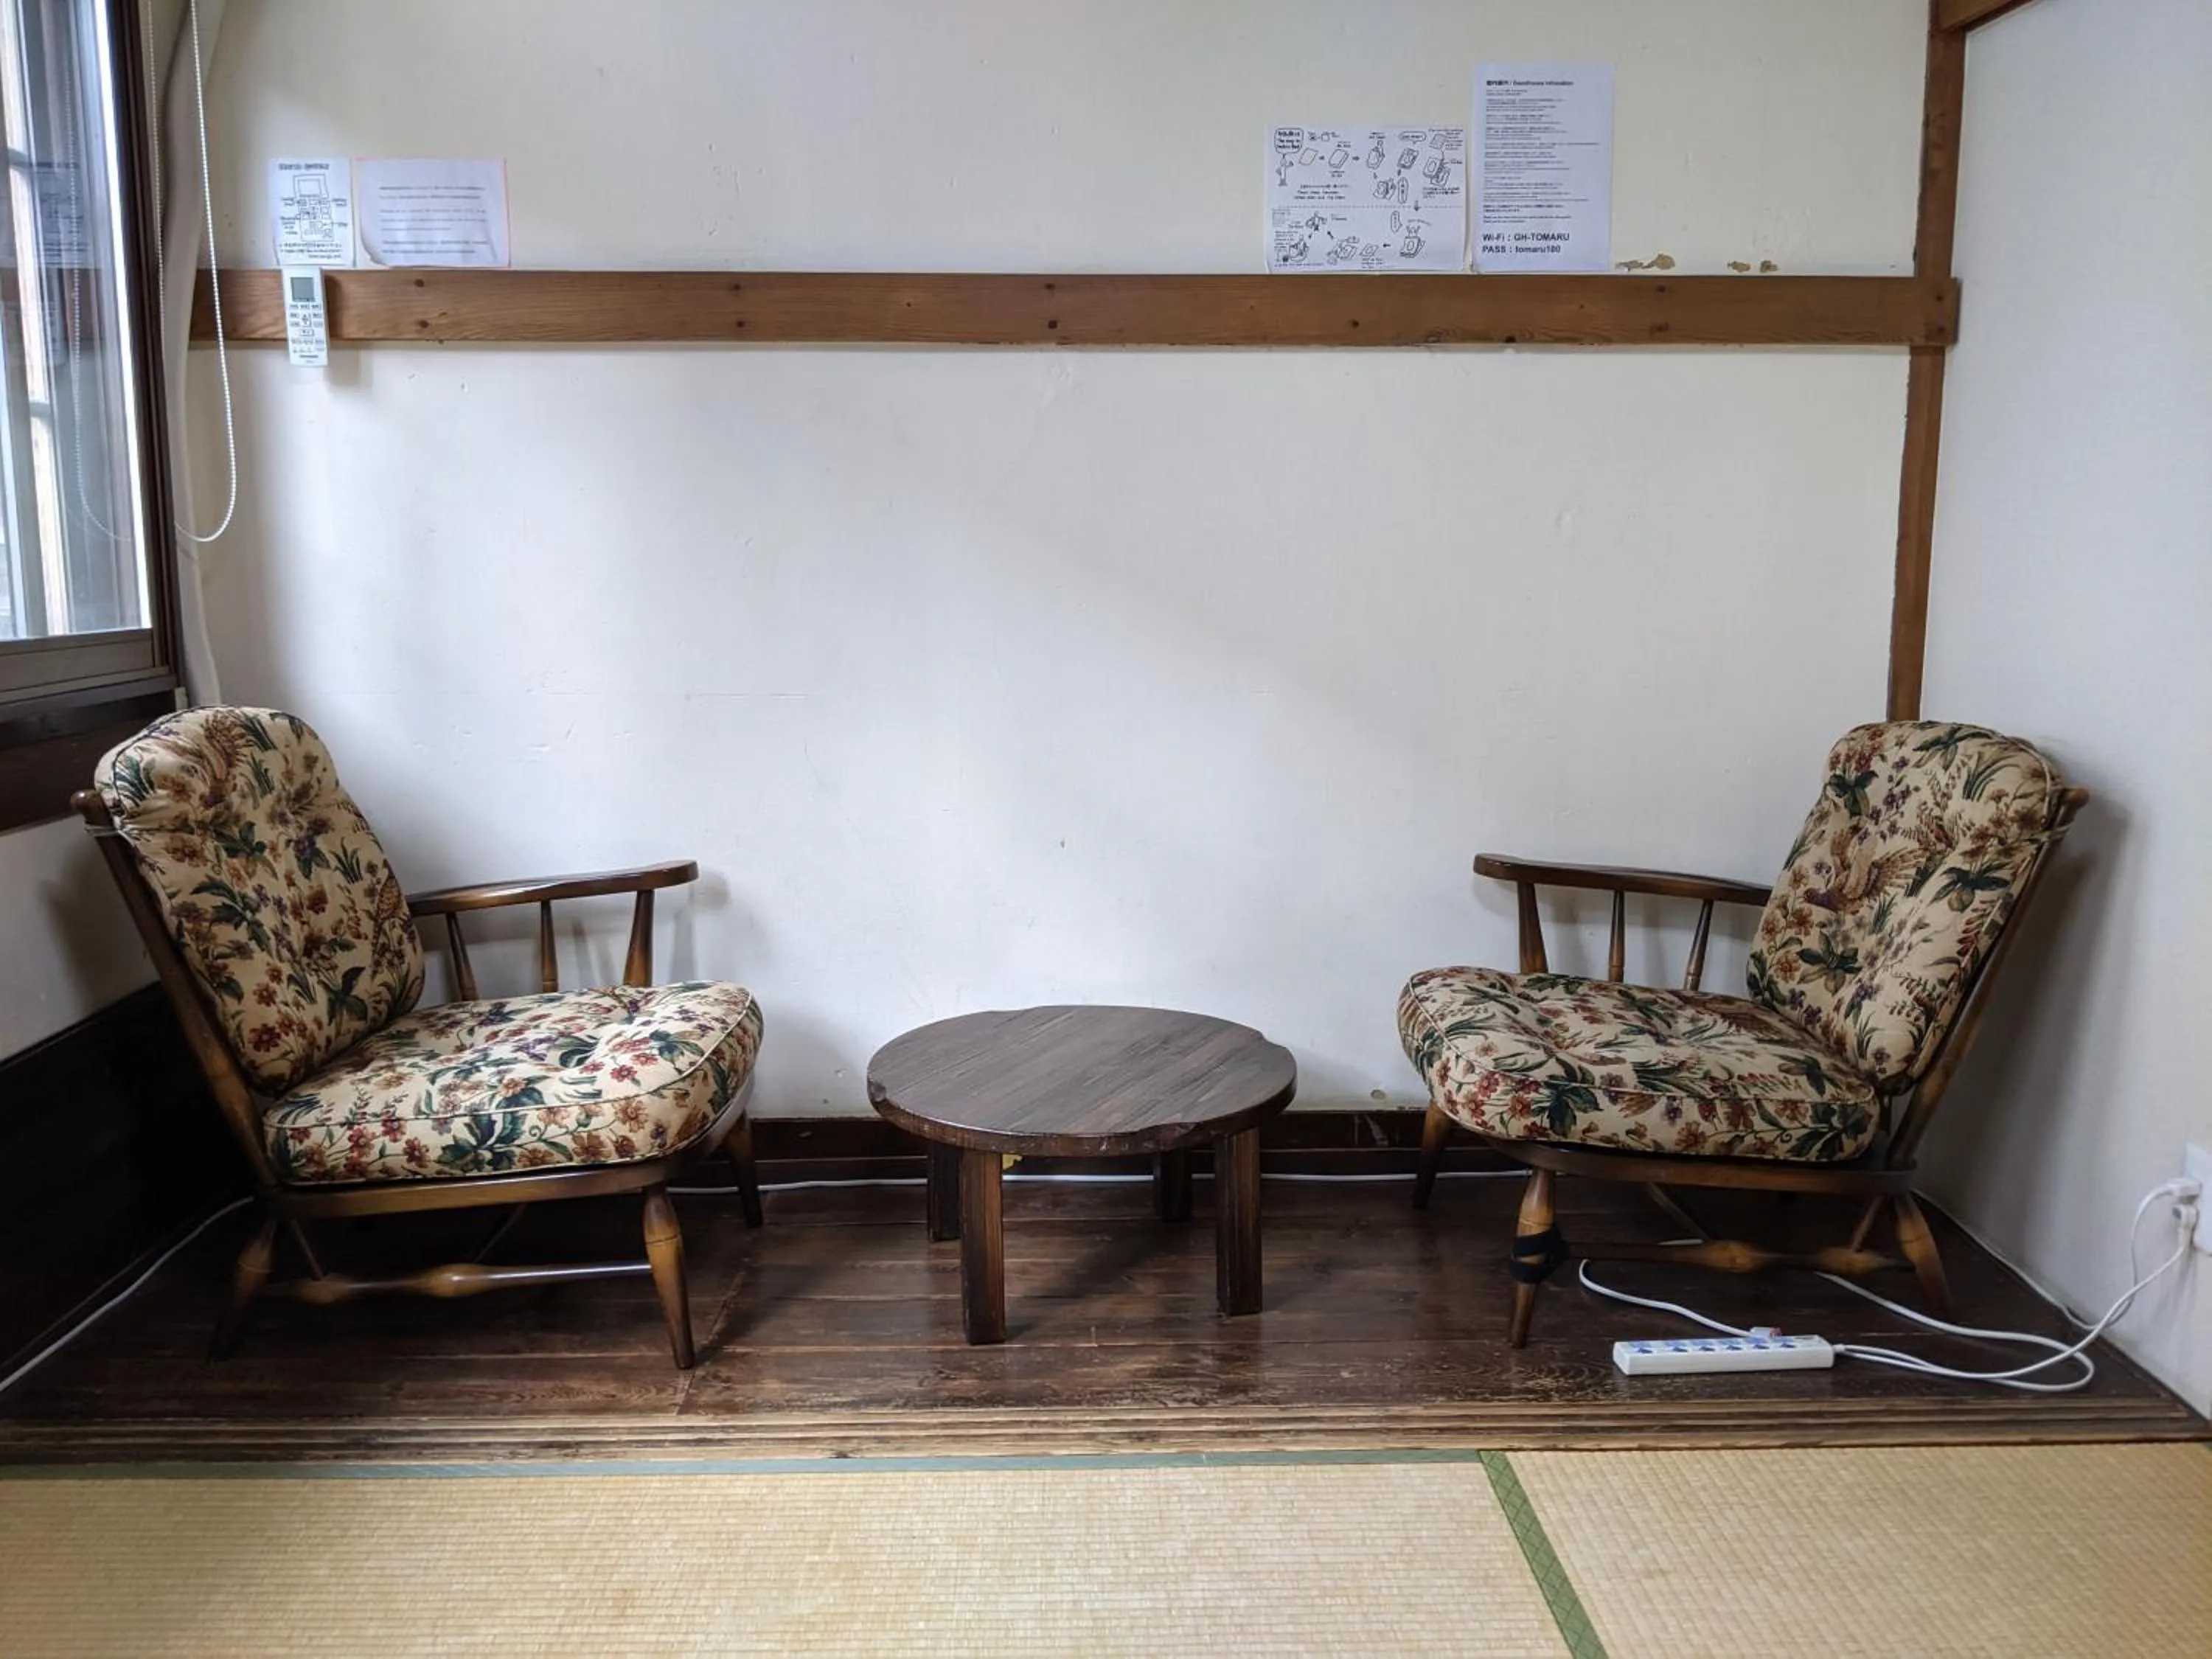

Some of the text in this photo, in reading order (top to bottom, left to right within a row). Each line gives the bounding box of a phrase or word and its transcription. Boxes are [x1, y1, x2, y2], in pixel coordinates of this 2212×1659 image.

[1482, 232, 1505, 242] Wi-Fi
[1514, 232, 1570, 242] GH-TOMARU
[1482, 245, 1506, 253] PASS
